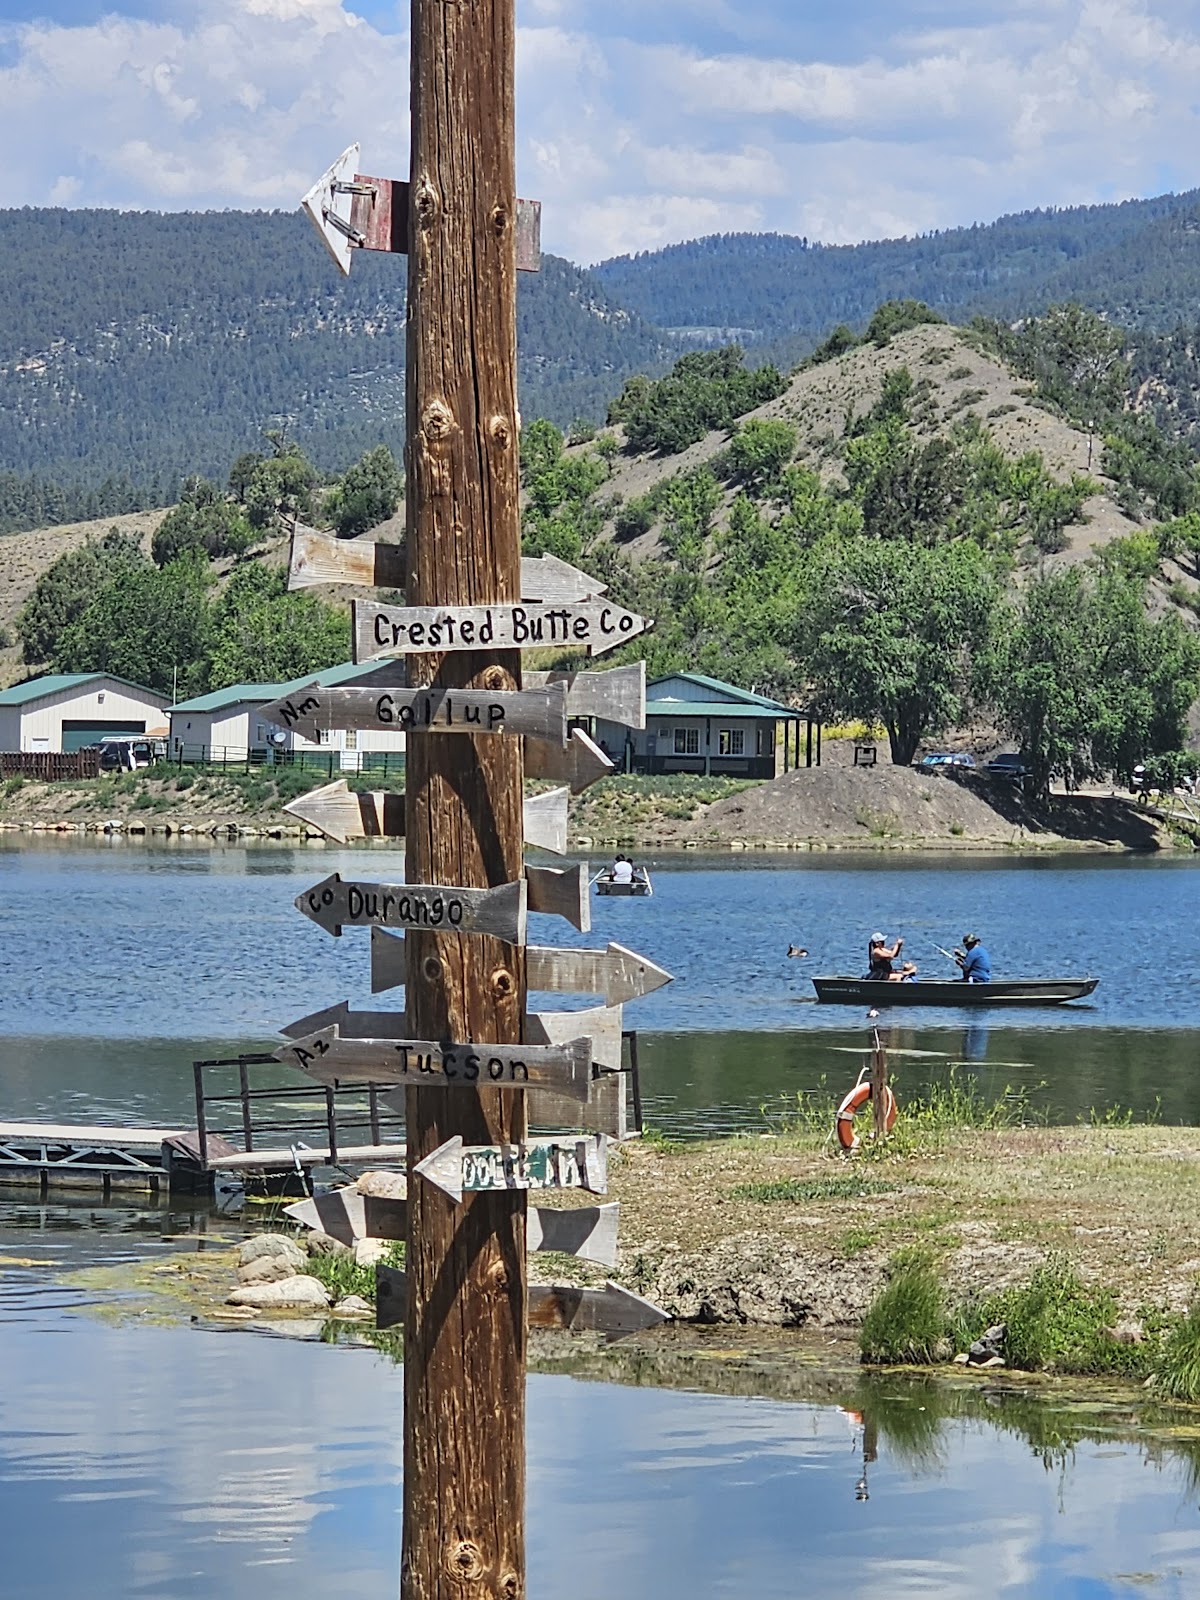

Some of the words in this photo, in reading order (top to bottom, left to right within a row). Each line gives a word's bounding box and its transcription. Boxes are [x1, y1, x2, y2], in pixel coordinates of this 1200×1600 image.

[374, 610, 494, 645] Crested
[512, 607, 590, 642] Butte
[376, 694, 505, 729] Gallup
[348, 885, 463, 925] Durango
[395, 1045, 529, 1081] Tucson
